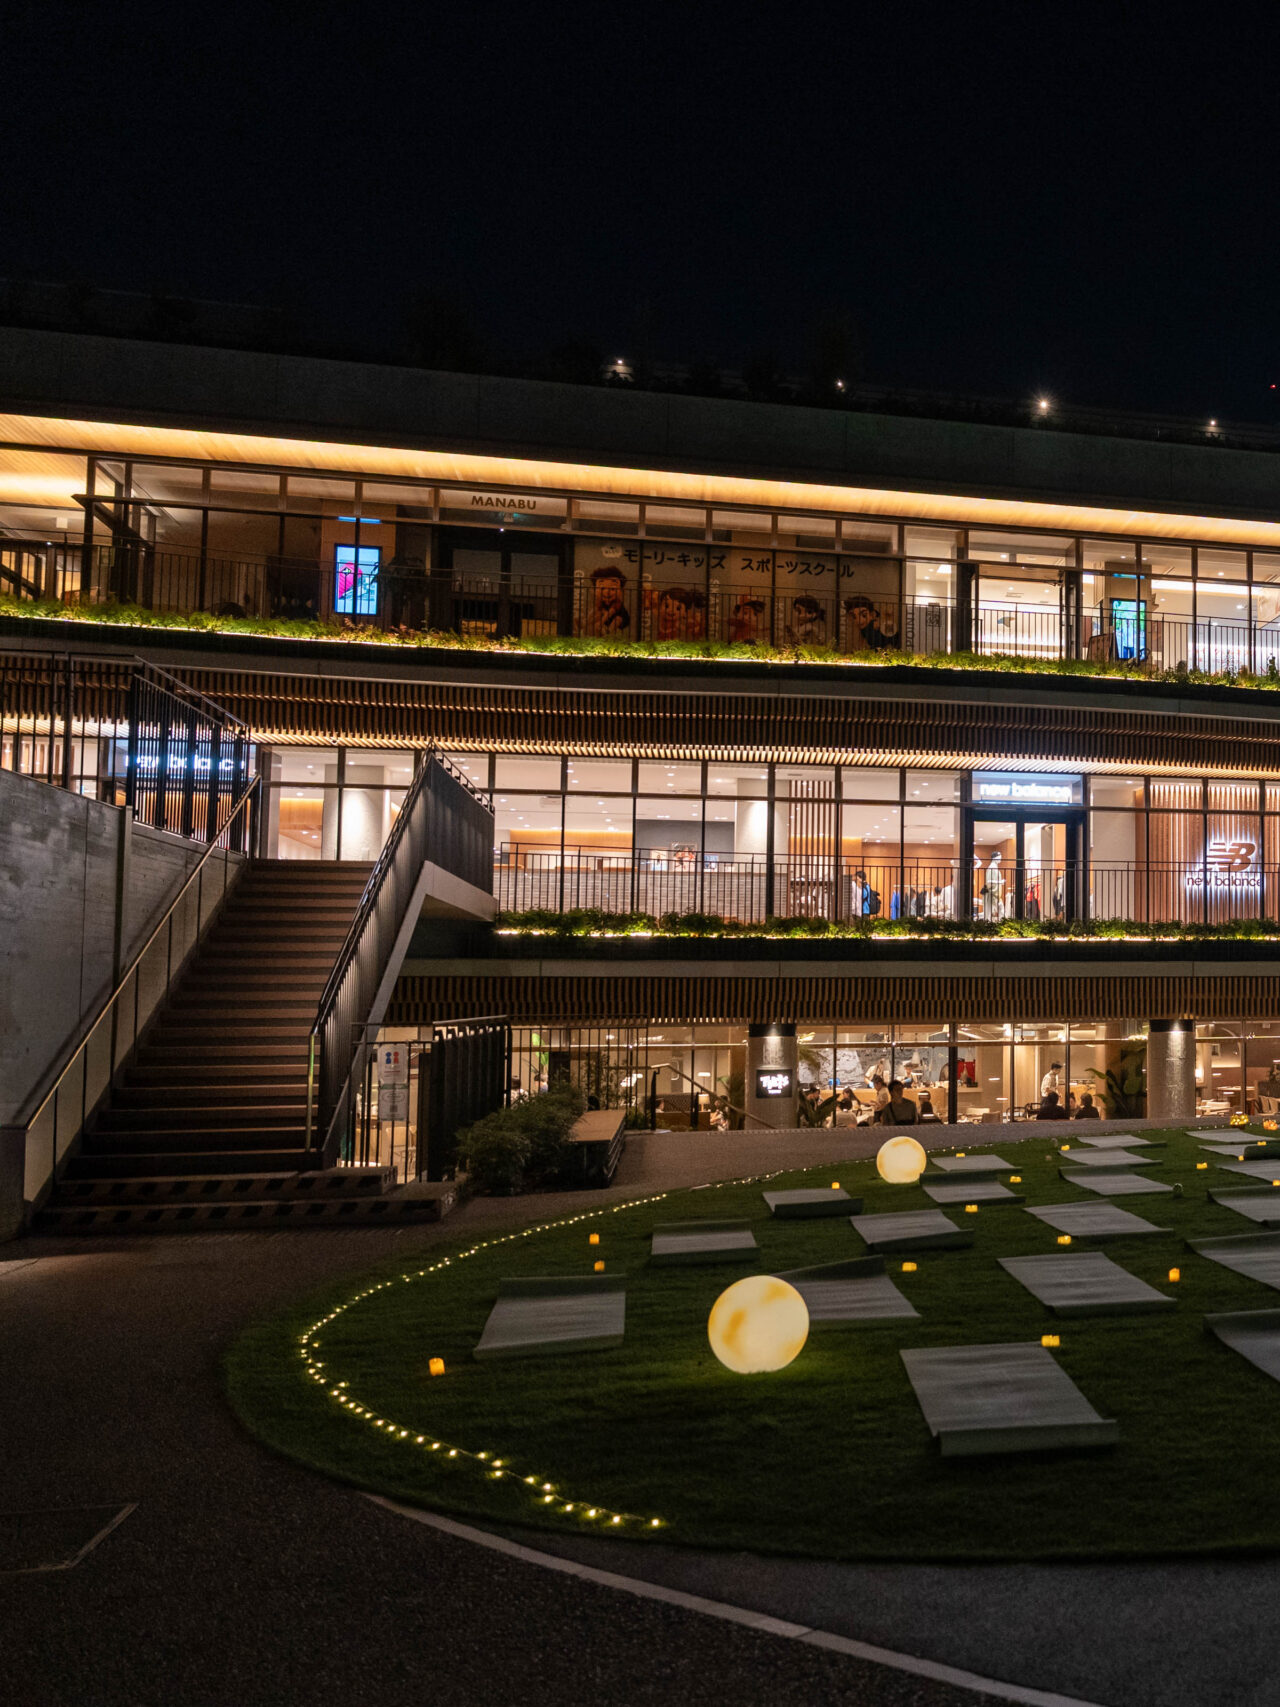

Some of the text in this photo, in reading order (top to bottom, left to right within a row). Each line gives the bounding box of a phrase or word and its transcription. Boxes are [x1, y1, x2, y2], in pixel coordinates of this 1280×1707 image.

[471, 495, 537, 511] MANABU
[740, 557, 855, 578] スポーツスクール
